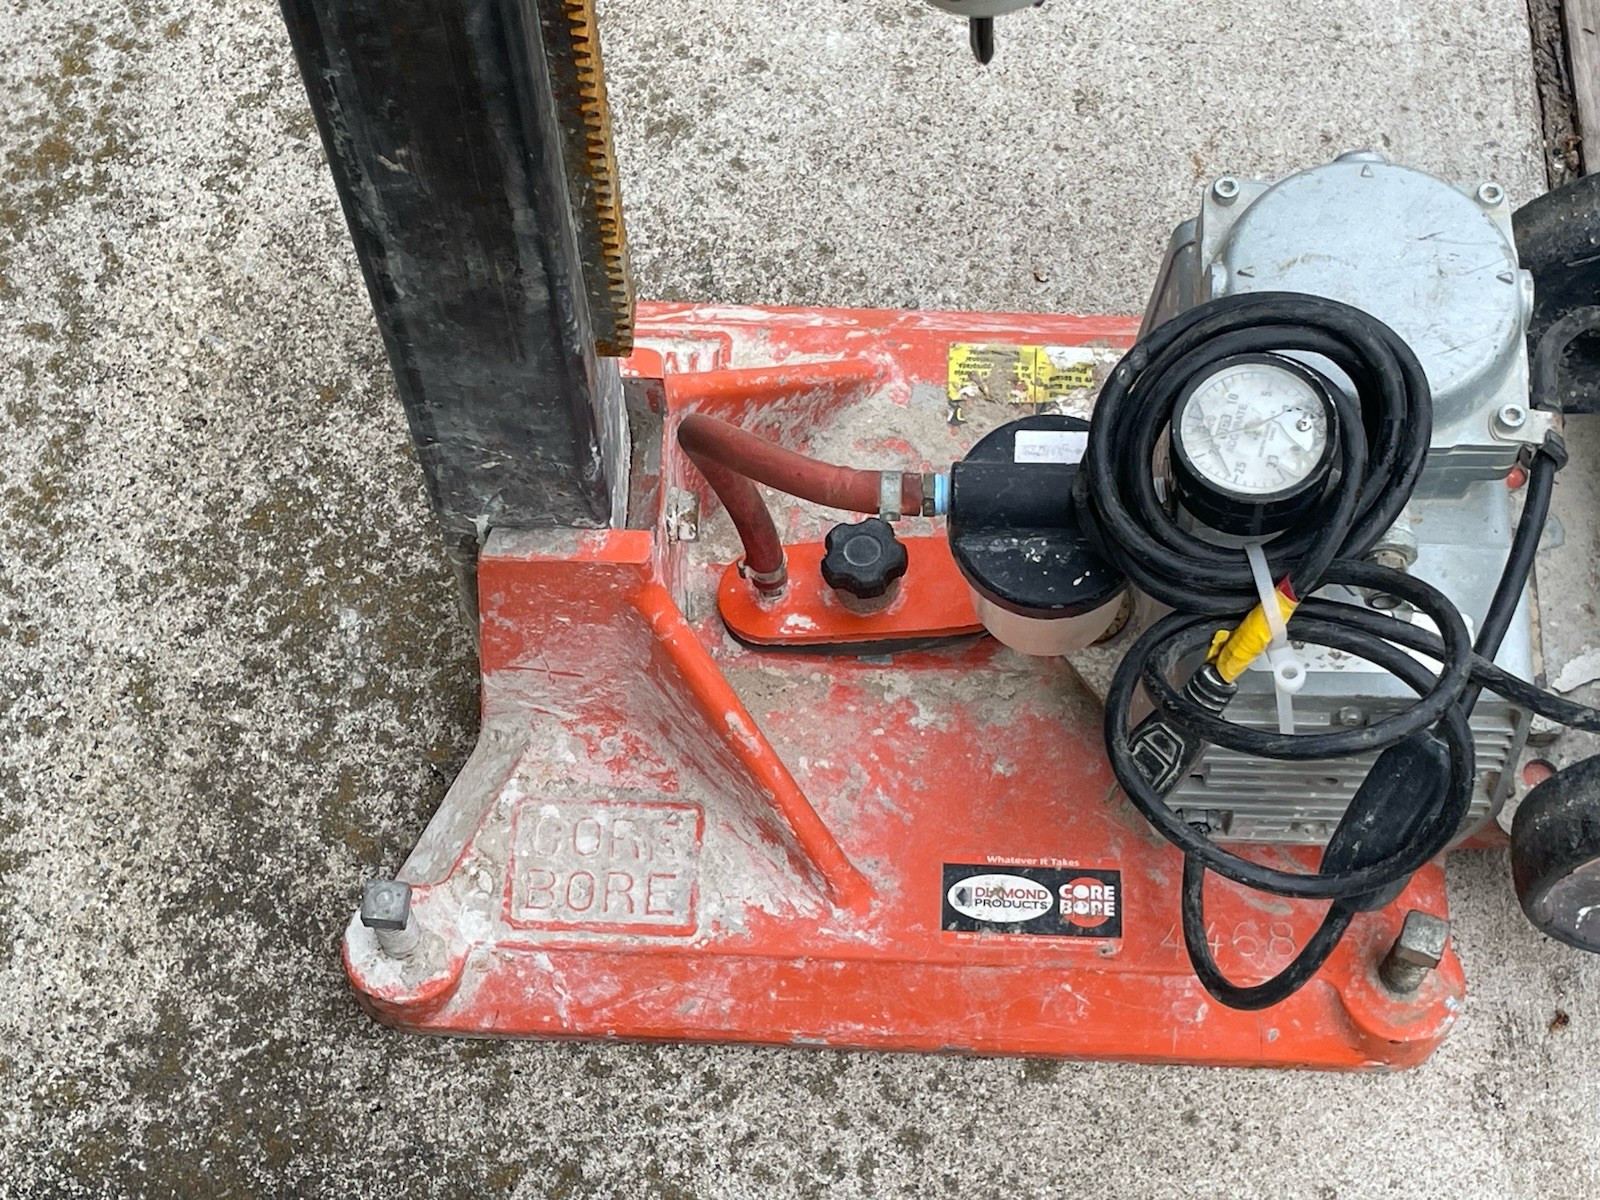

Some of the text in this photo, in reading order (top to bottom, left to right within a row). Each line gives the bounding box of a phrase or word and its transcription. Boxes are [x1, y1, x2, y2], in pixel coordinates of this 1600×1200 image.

[986, 855, 1080, 867] Whatever It Takes
[526, 868, 676, 916] BORE
[974, 886, 1048, 900] DIAMOND
[1058, 884, 1115, 901] CORE
[974, 899, 1048, 910] PRODUCTS
[1059, 900, 1115, 917] BORE
